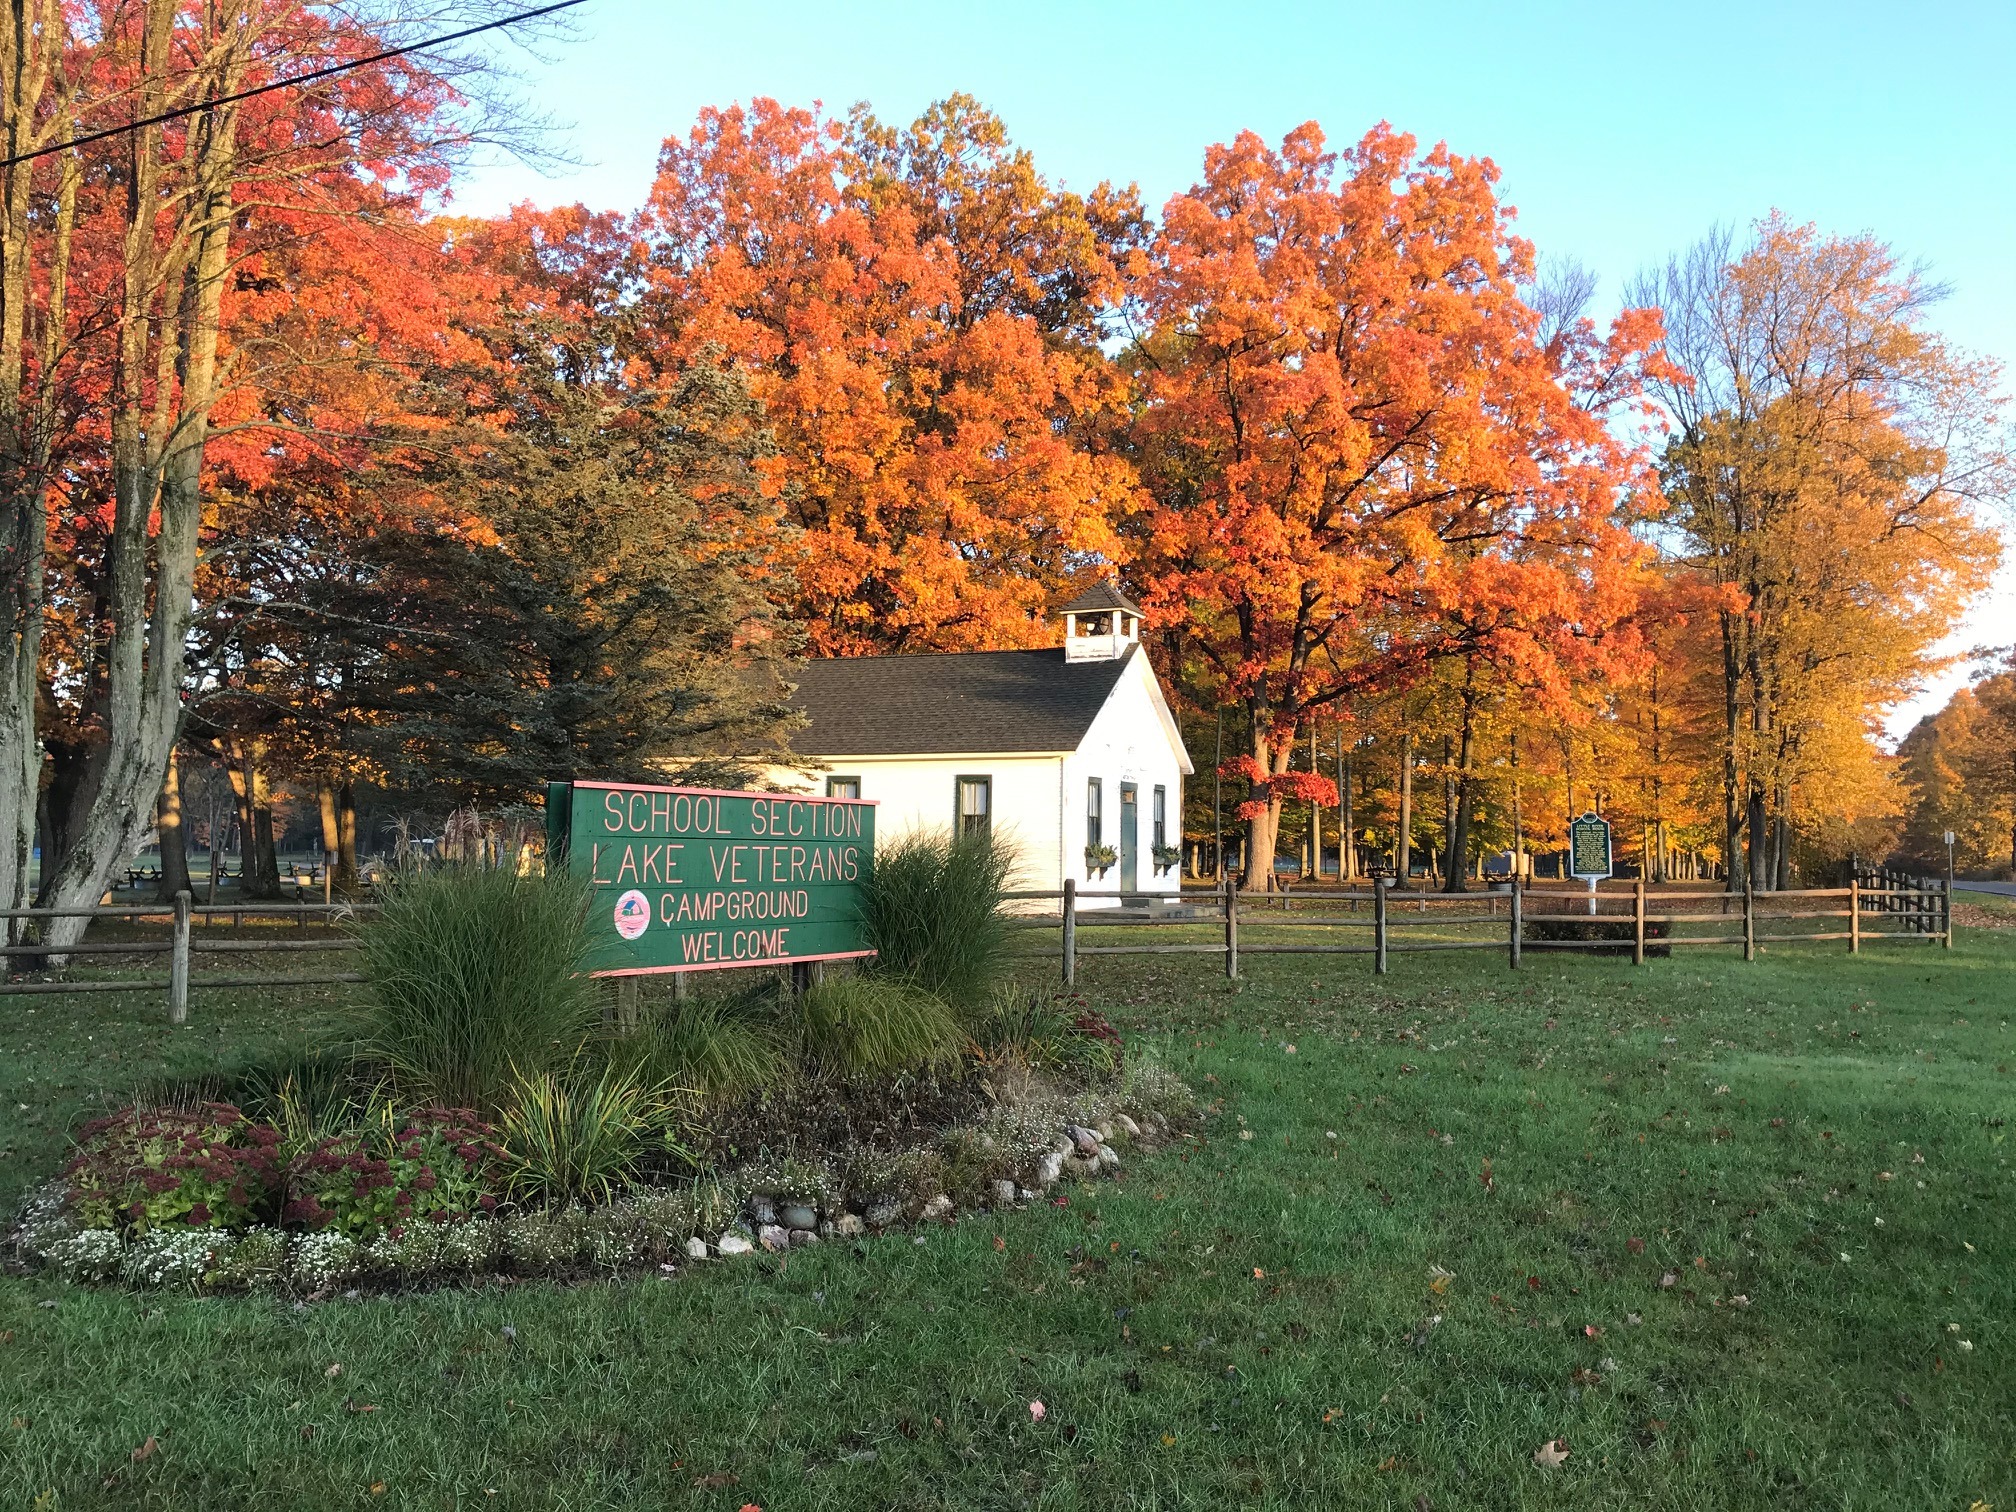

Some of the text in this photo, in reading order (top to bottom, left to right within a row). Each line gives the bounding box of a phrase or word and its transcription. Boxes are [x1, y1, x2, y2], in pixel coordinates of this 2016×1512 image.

[605, 790, 861, 837] SCHOOL SECTION
[592, 843, 858, 884] LAKE VETERANS
[660, 890, 808, 923] CAMPGROUND
[681, 928, 790, 962] WELCOME
